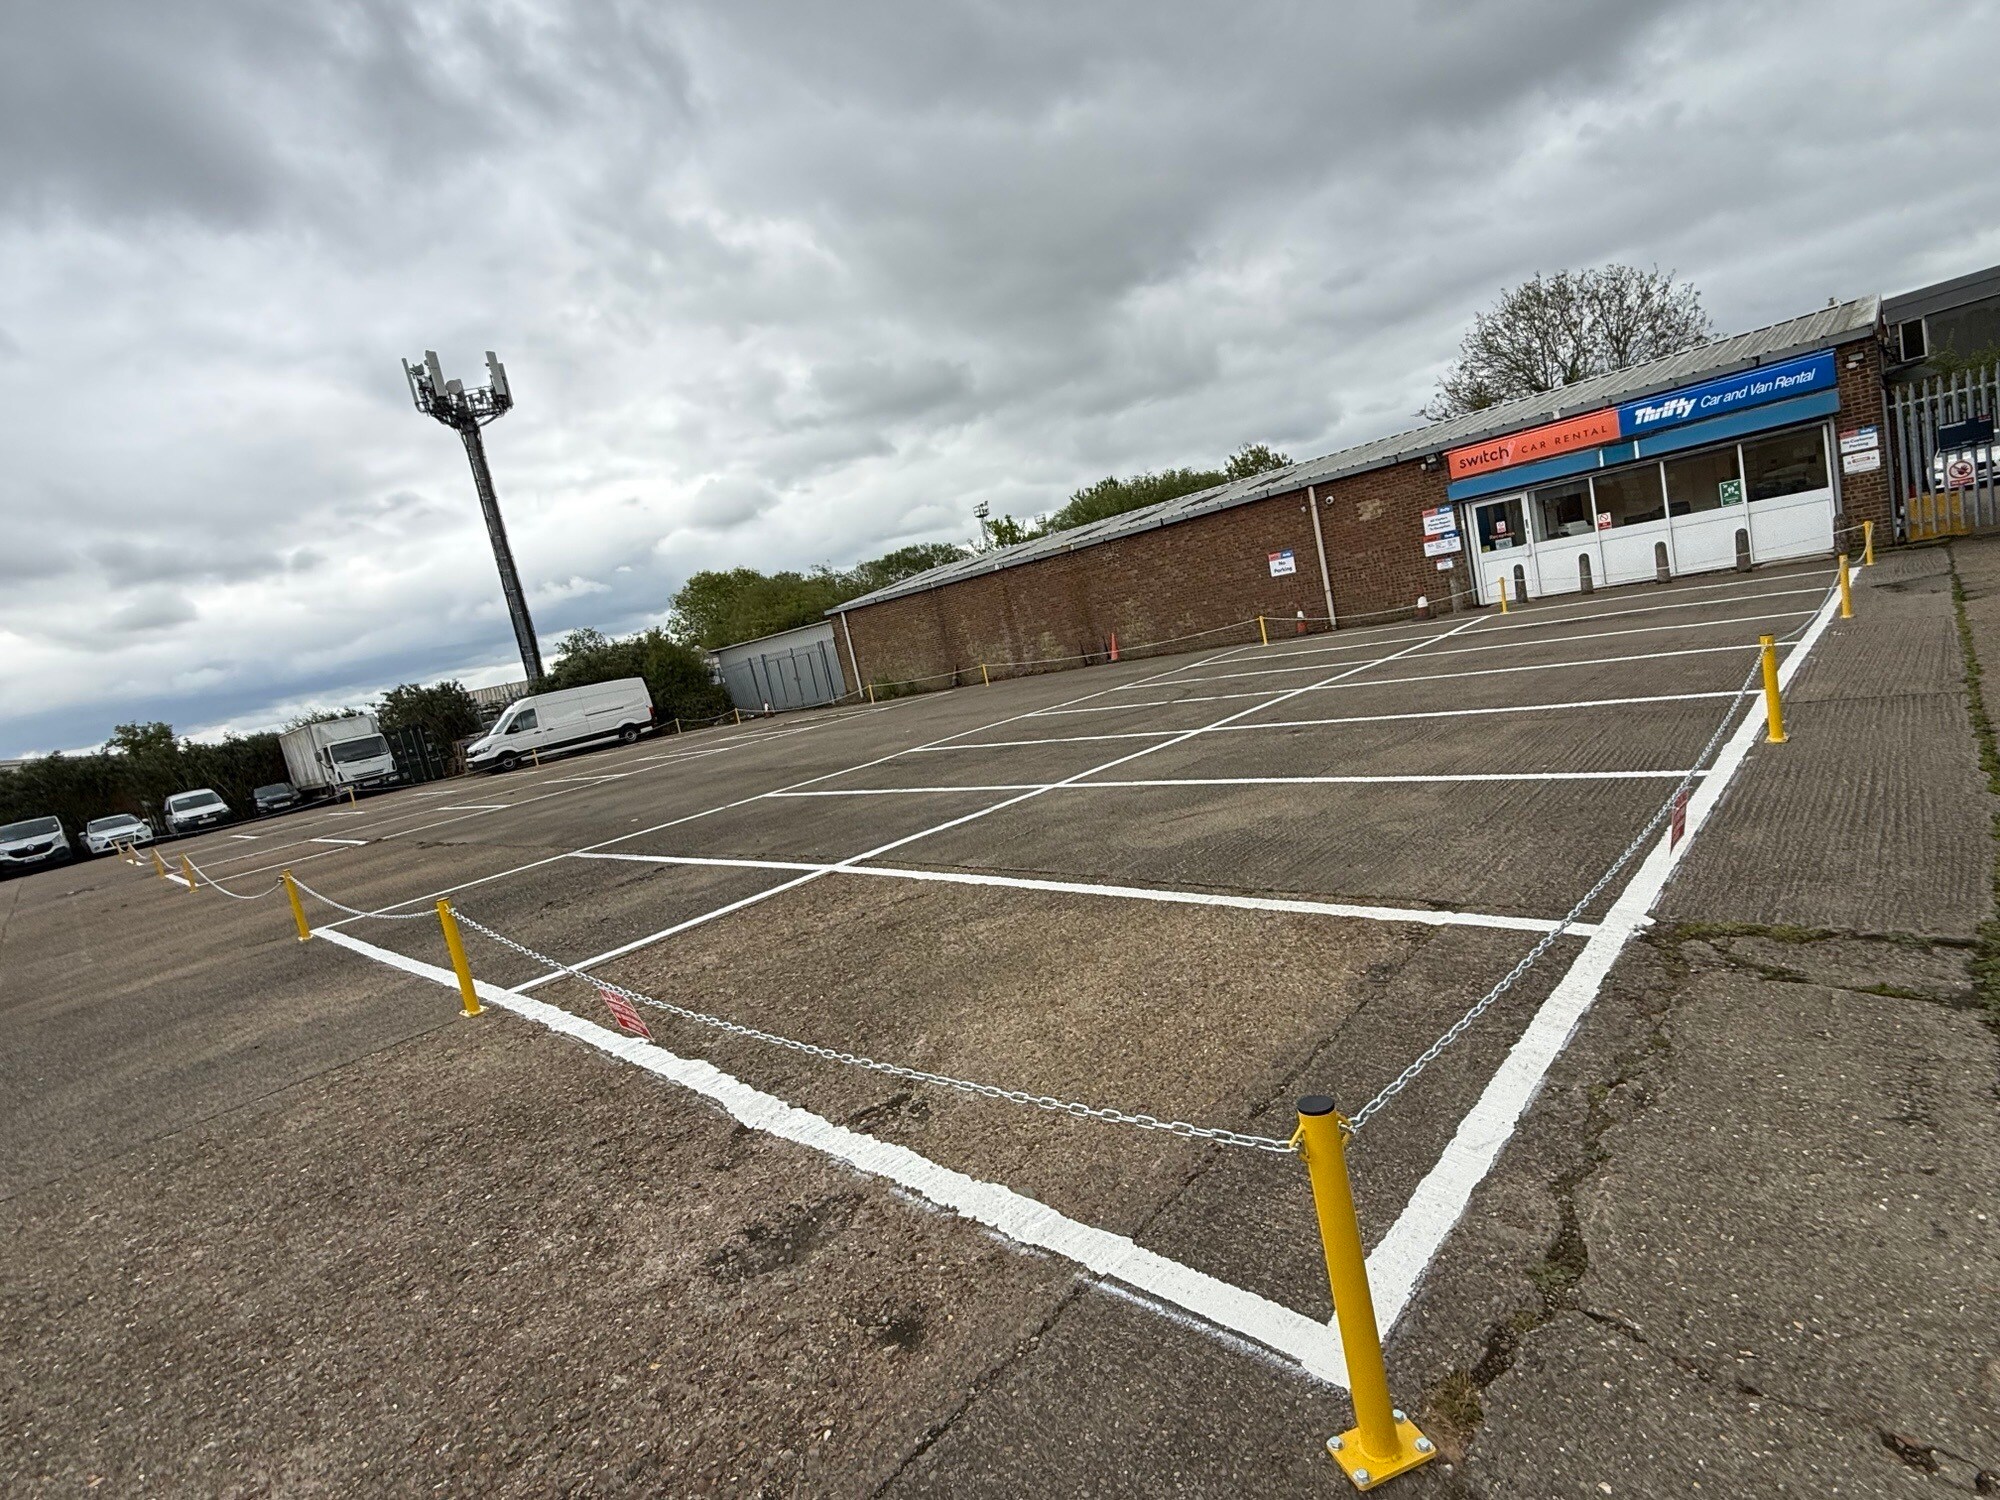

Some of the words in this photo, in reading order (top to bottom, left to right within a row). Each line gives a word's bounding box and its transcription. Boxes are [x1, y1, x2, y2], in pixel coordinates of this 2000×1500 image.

[1634, 397, 1697, 425] Thrifty
[1700, 394, 1722, 409] Car
[1723, 386, 1748, 403] and
[1750, 380, 1773, 396] Van
[1774, 367, 1816, 390] Rental
[1459, 446, 1509, 469] switch
[1521, 441, 1547, 453] CAR
[1554, 425, 1608, 445] RENTAL
